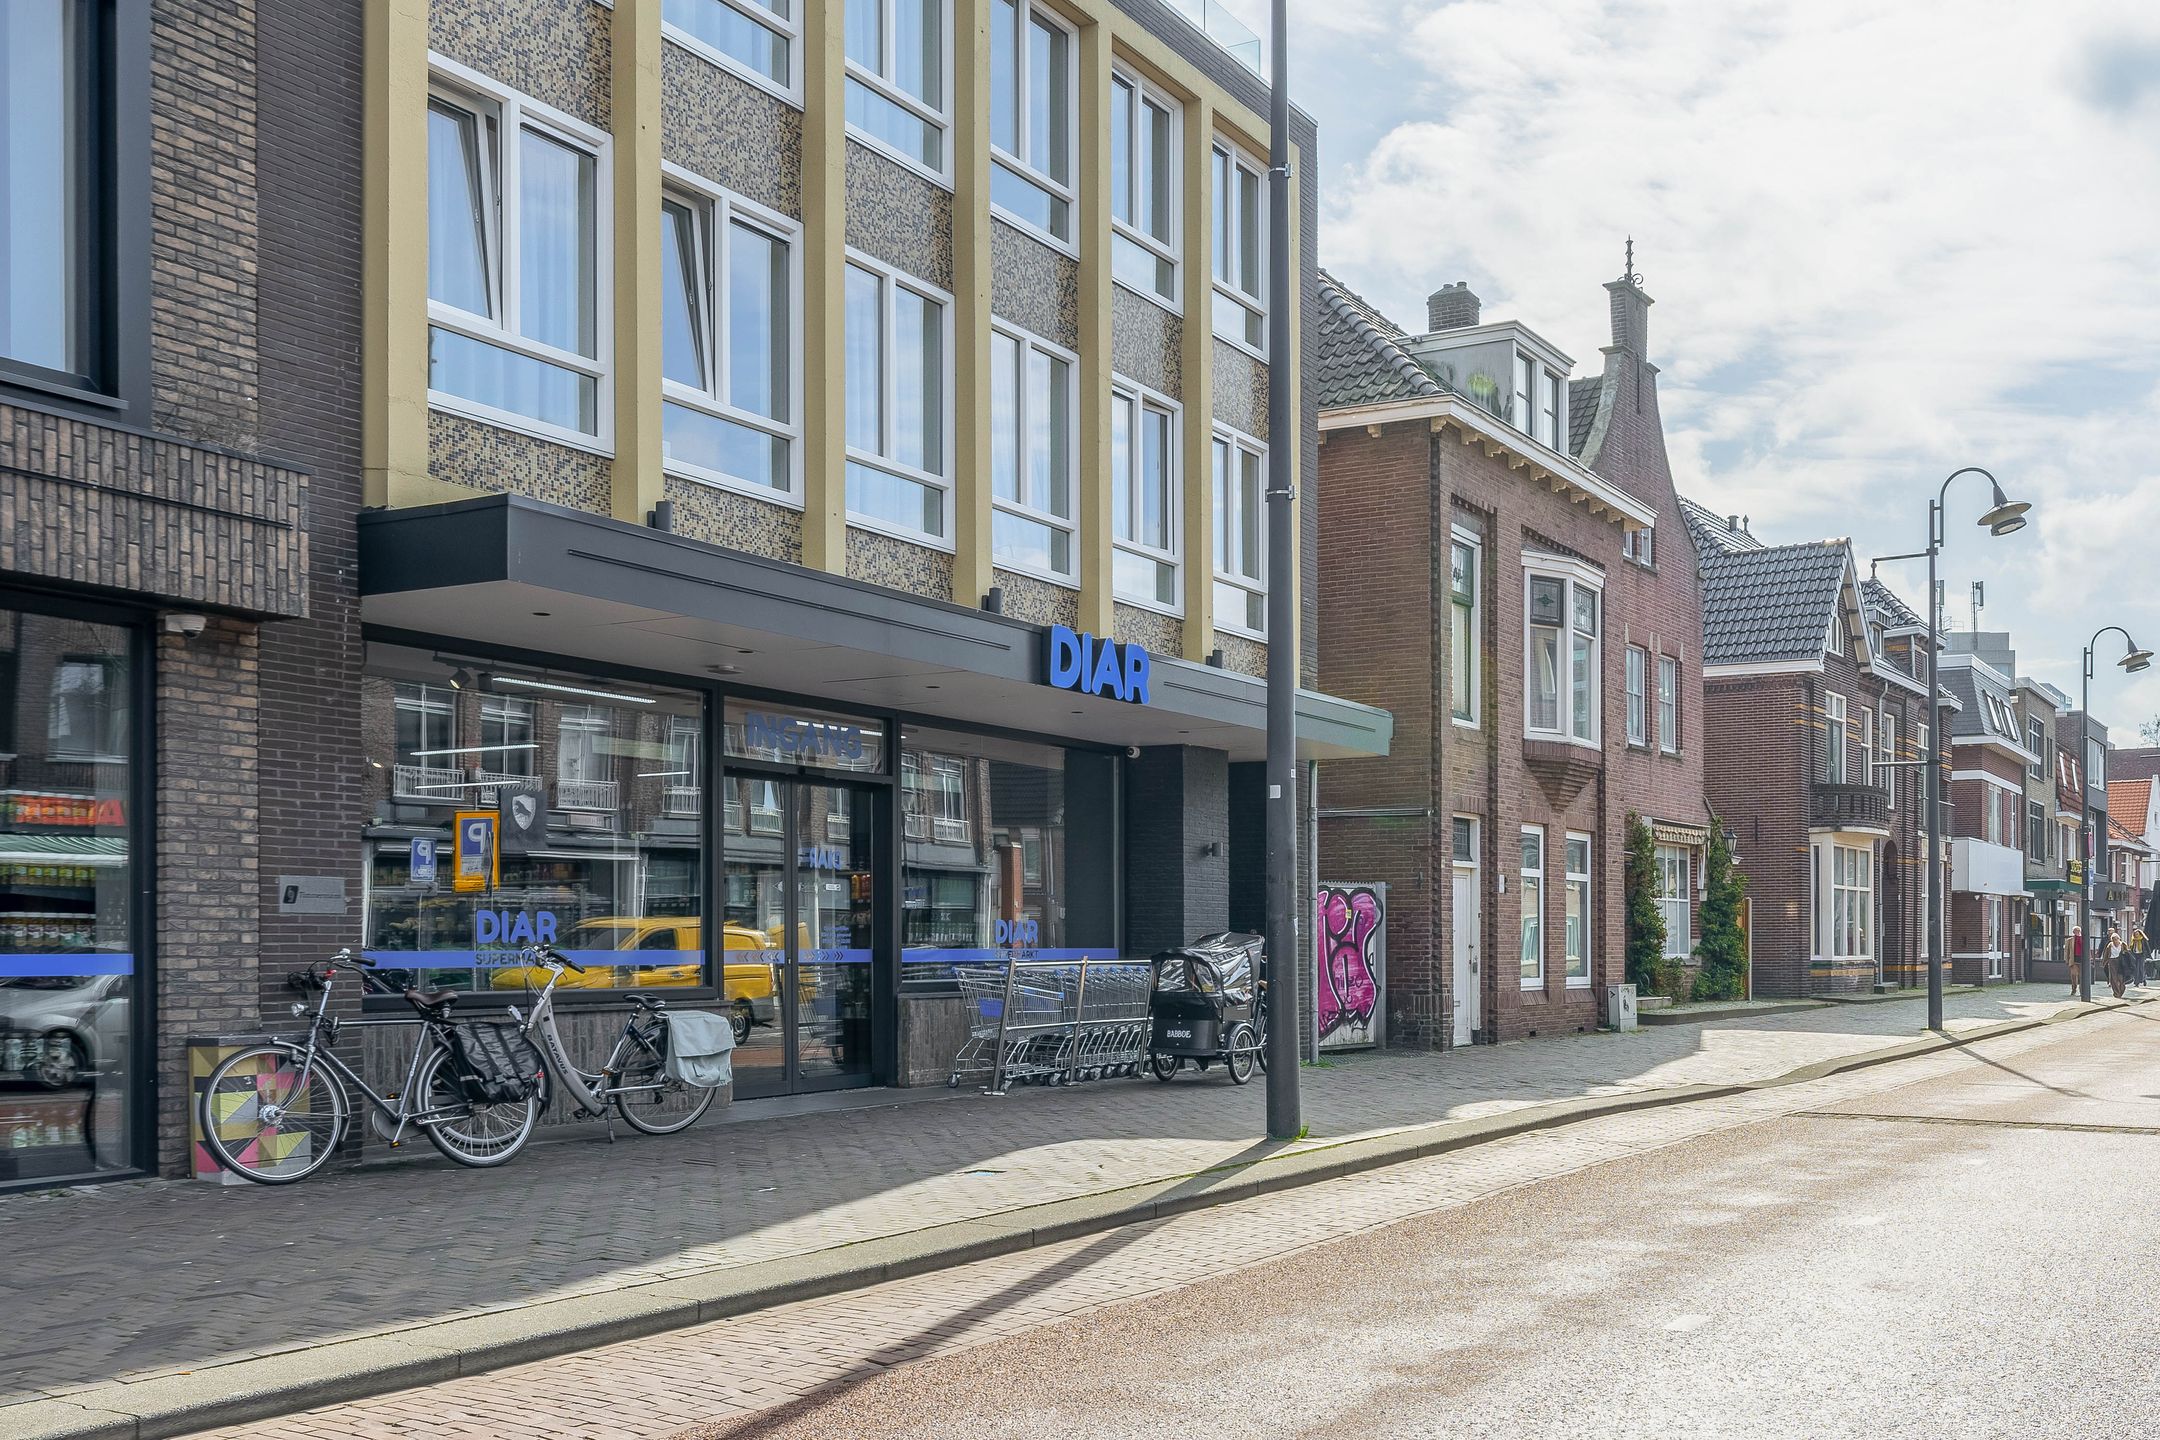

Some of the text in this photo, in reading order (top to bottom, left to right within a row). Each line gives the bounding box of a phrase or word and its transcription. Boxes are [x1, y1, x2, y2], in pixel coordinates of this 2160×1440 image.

[1050, 623, 1150, 705] DIAR
[745, 711, 863, 760] INGANG
[476, 909, 557, 944] DIAR
[995, 919, 1038, 944] DIAR
[1166, 1029, 1192, 1039] BABBOE
[547, 1034, 569, 1075] BATAVUS
